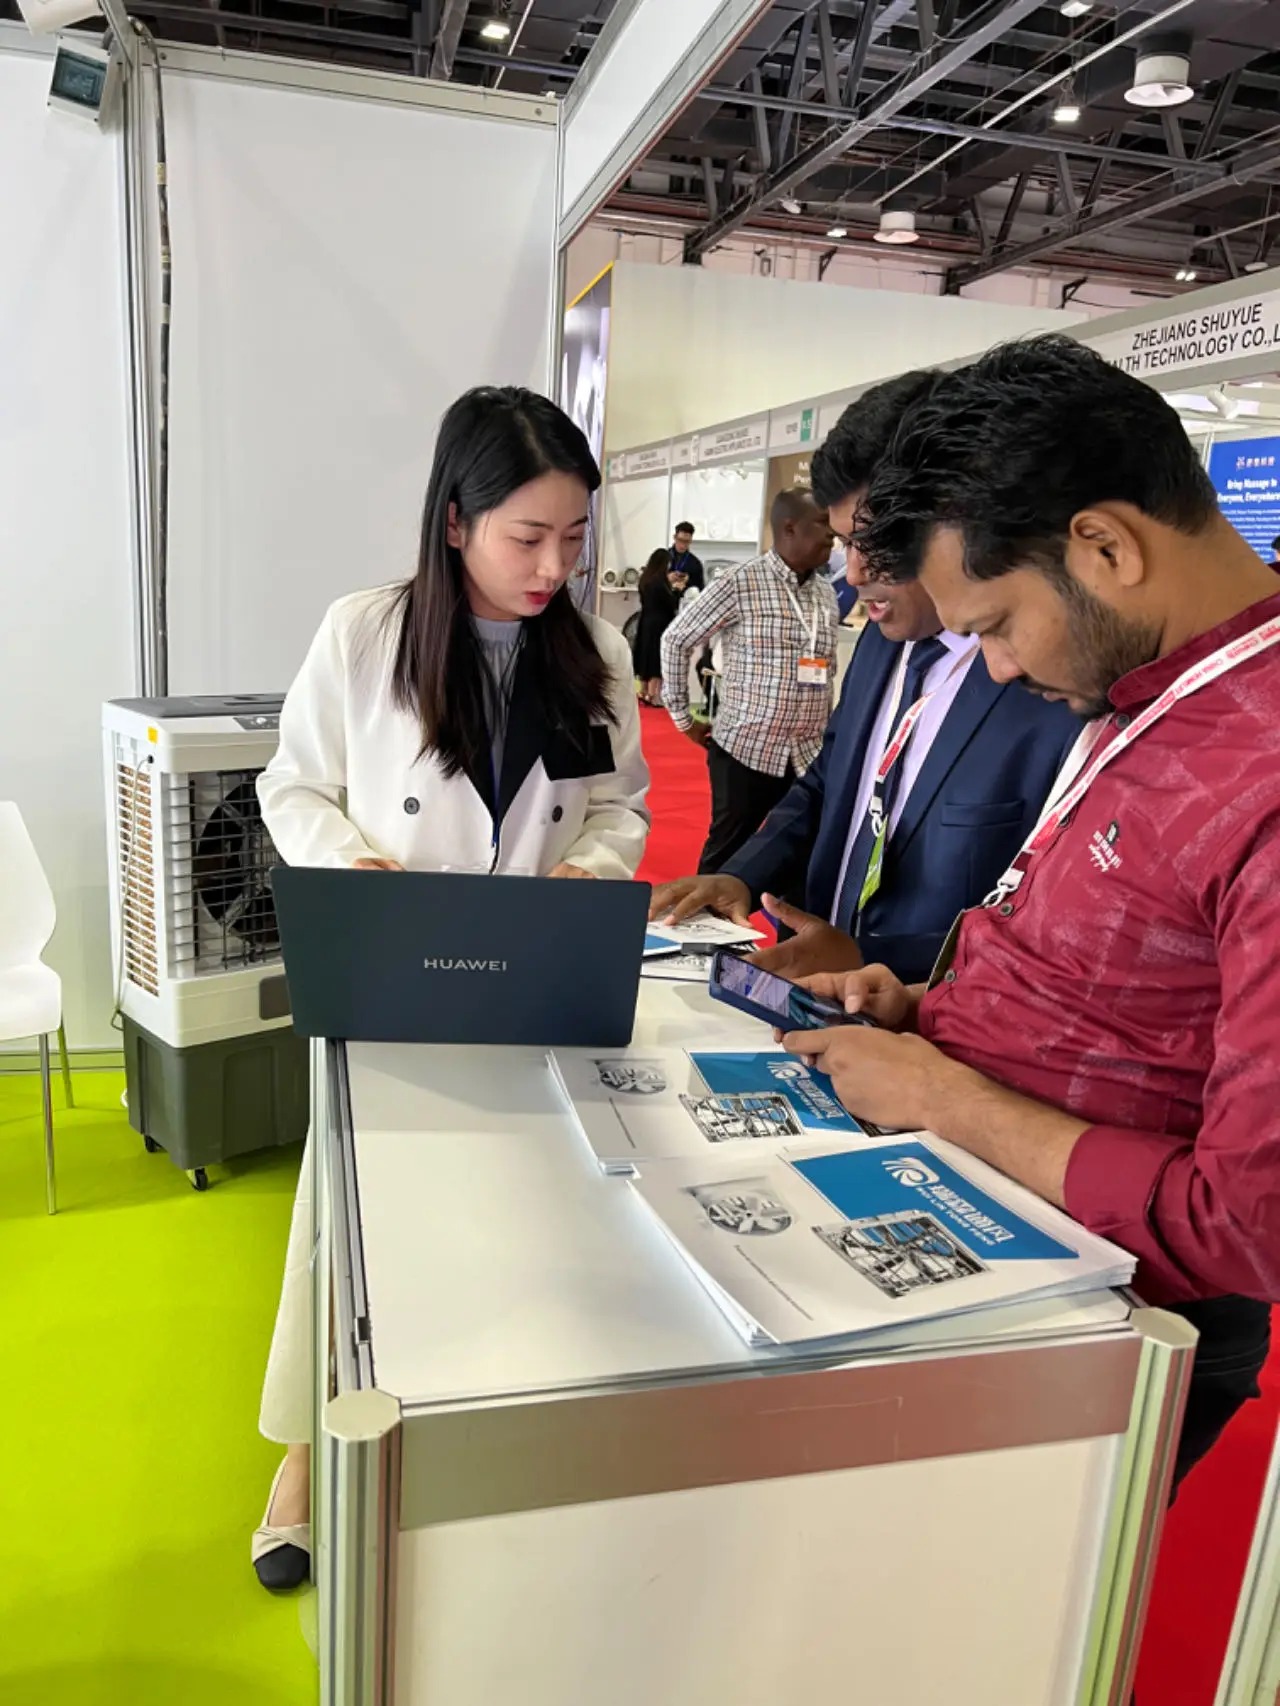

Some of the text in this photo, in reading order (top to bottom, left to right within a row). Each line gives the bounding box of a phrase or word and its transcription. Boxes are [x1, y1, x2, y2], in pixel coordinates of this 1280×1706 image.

[1132, 303, 1263, 351] ZHEJIANG SHUYUE
[1144, 333, 1239, 368] TECHNOLOGY
[424, 958, 507, 971] HUAWEI
